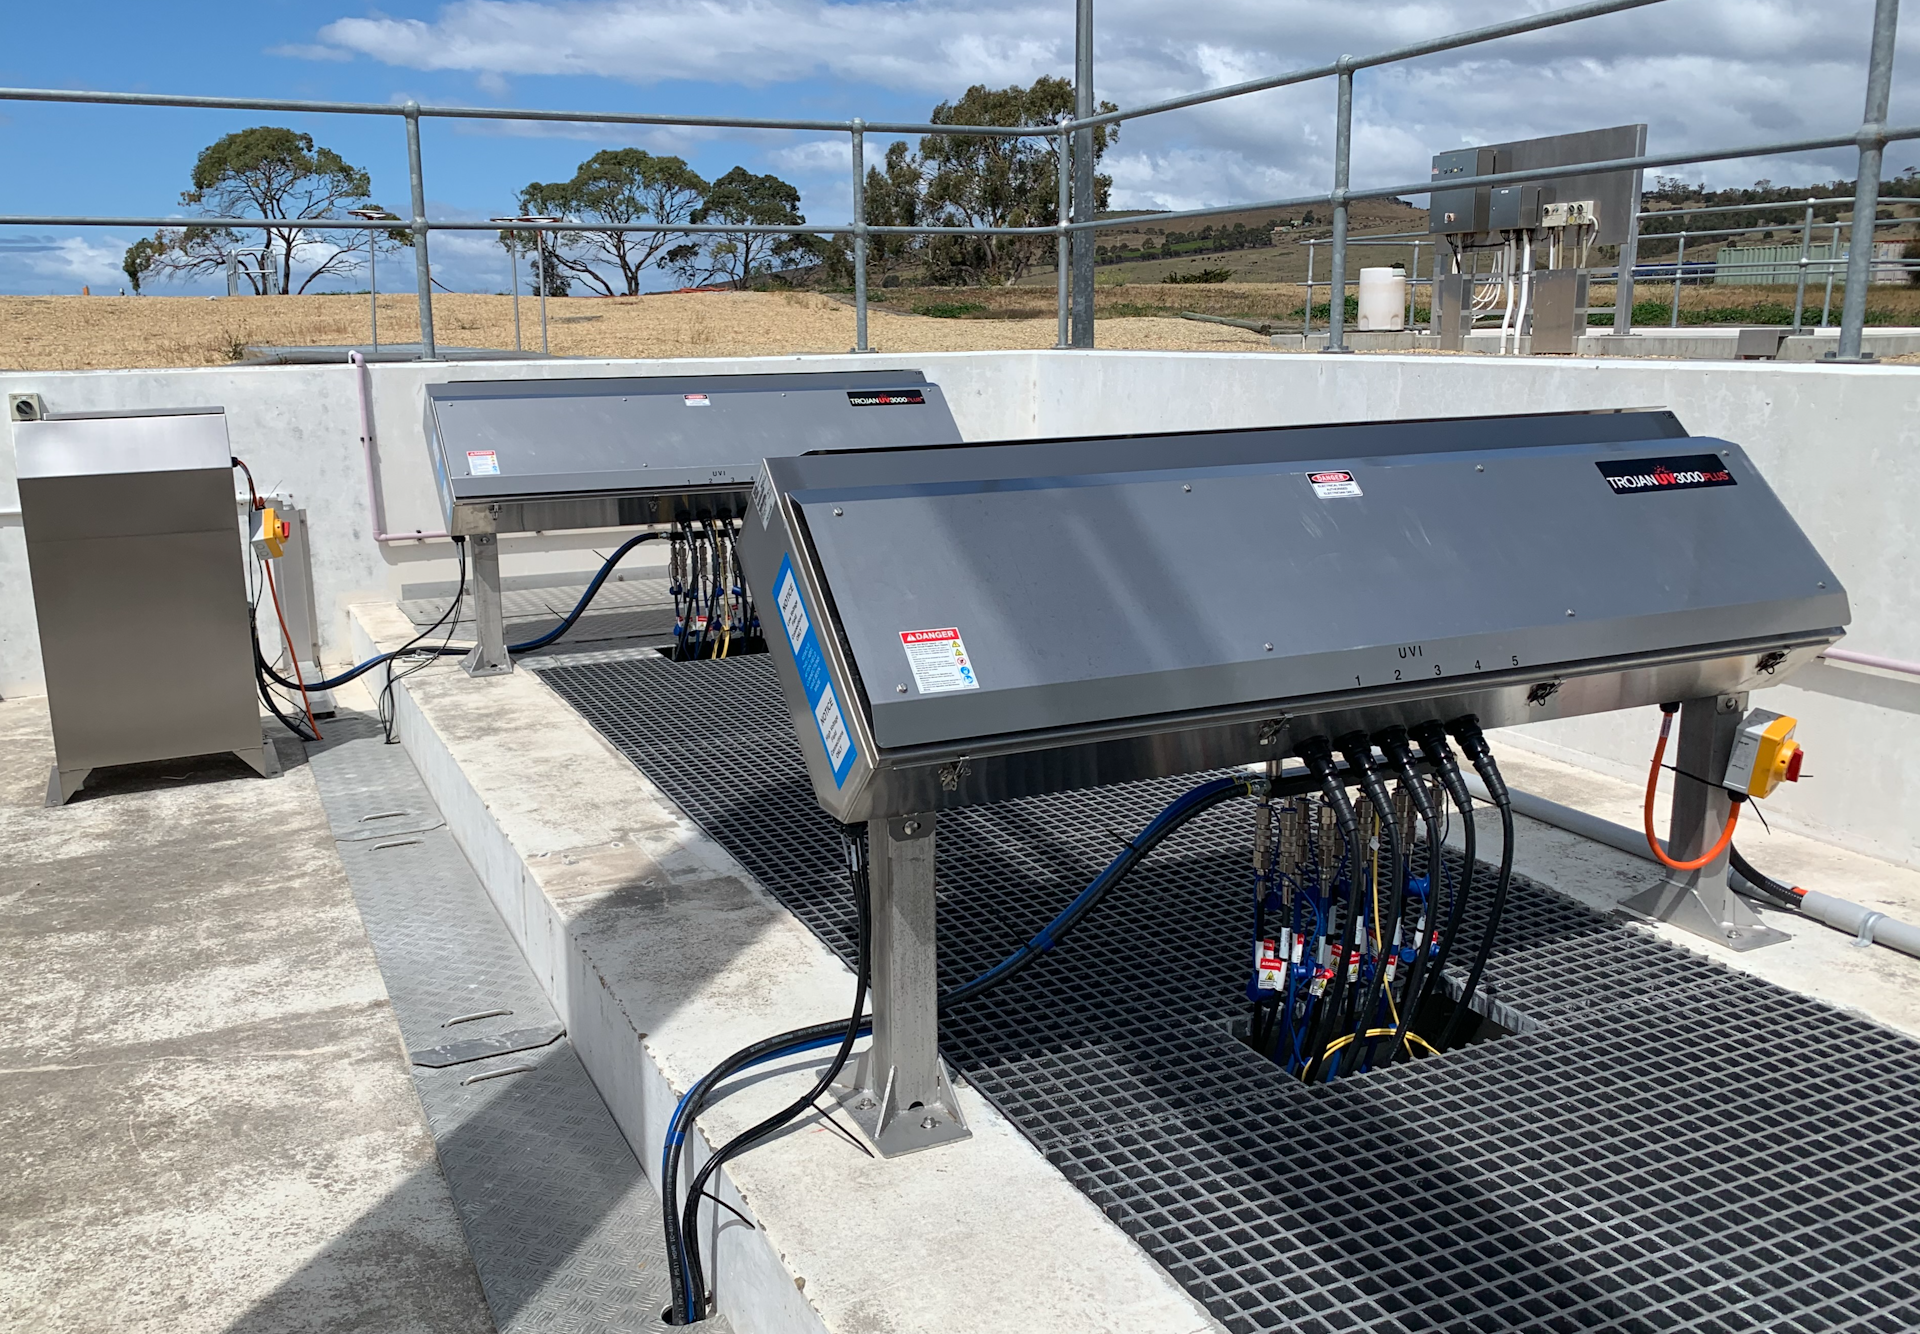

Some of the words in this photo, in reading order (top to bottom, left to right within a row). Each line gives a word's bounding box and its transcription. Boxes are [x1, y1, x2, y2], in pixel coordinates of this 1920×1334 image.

[1316, 473, 1344, 481] DANGER
[782, 583, 794, 613] NOTICE
[915, 630, 955, 640] DANGER
[1398, 645, 1423, 659] UVI
[1355, 675, 1361, 686] 1
[1394, 669, 1401, 681] 2
[1434, 664, 1441, 676] 3
[1475, 659, 1481, 671] 4
[1511, 655, 1518, 666] 5
[820, 697, 833, 726] NOTICE
